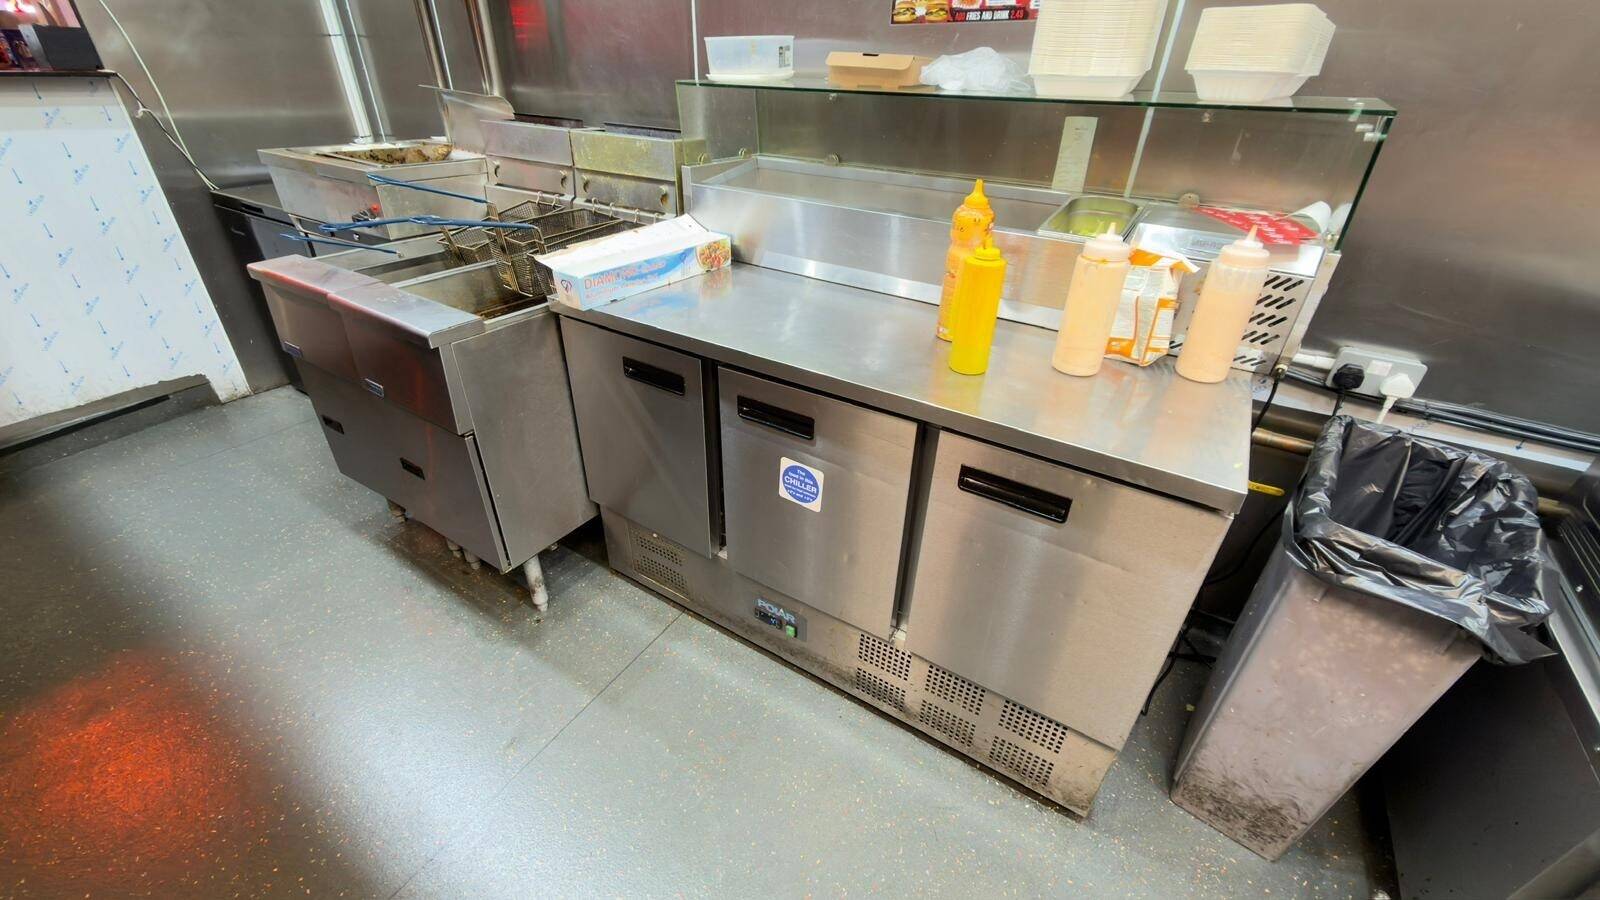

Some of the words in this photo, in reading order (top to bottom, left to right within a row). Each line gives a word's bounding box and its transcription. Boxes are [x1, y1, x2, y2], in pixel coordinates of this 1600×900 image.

[966, 11, 981, 21] FRIES
[981, 11, 993, 20] AND
[993, 10, 1010, 20] DRINK
[784, 475, 817, 494] CHILLER
[757, 598, 796, 624] POLAR
